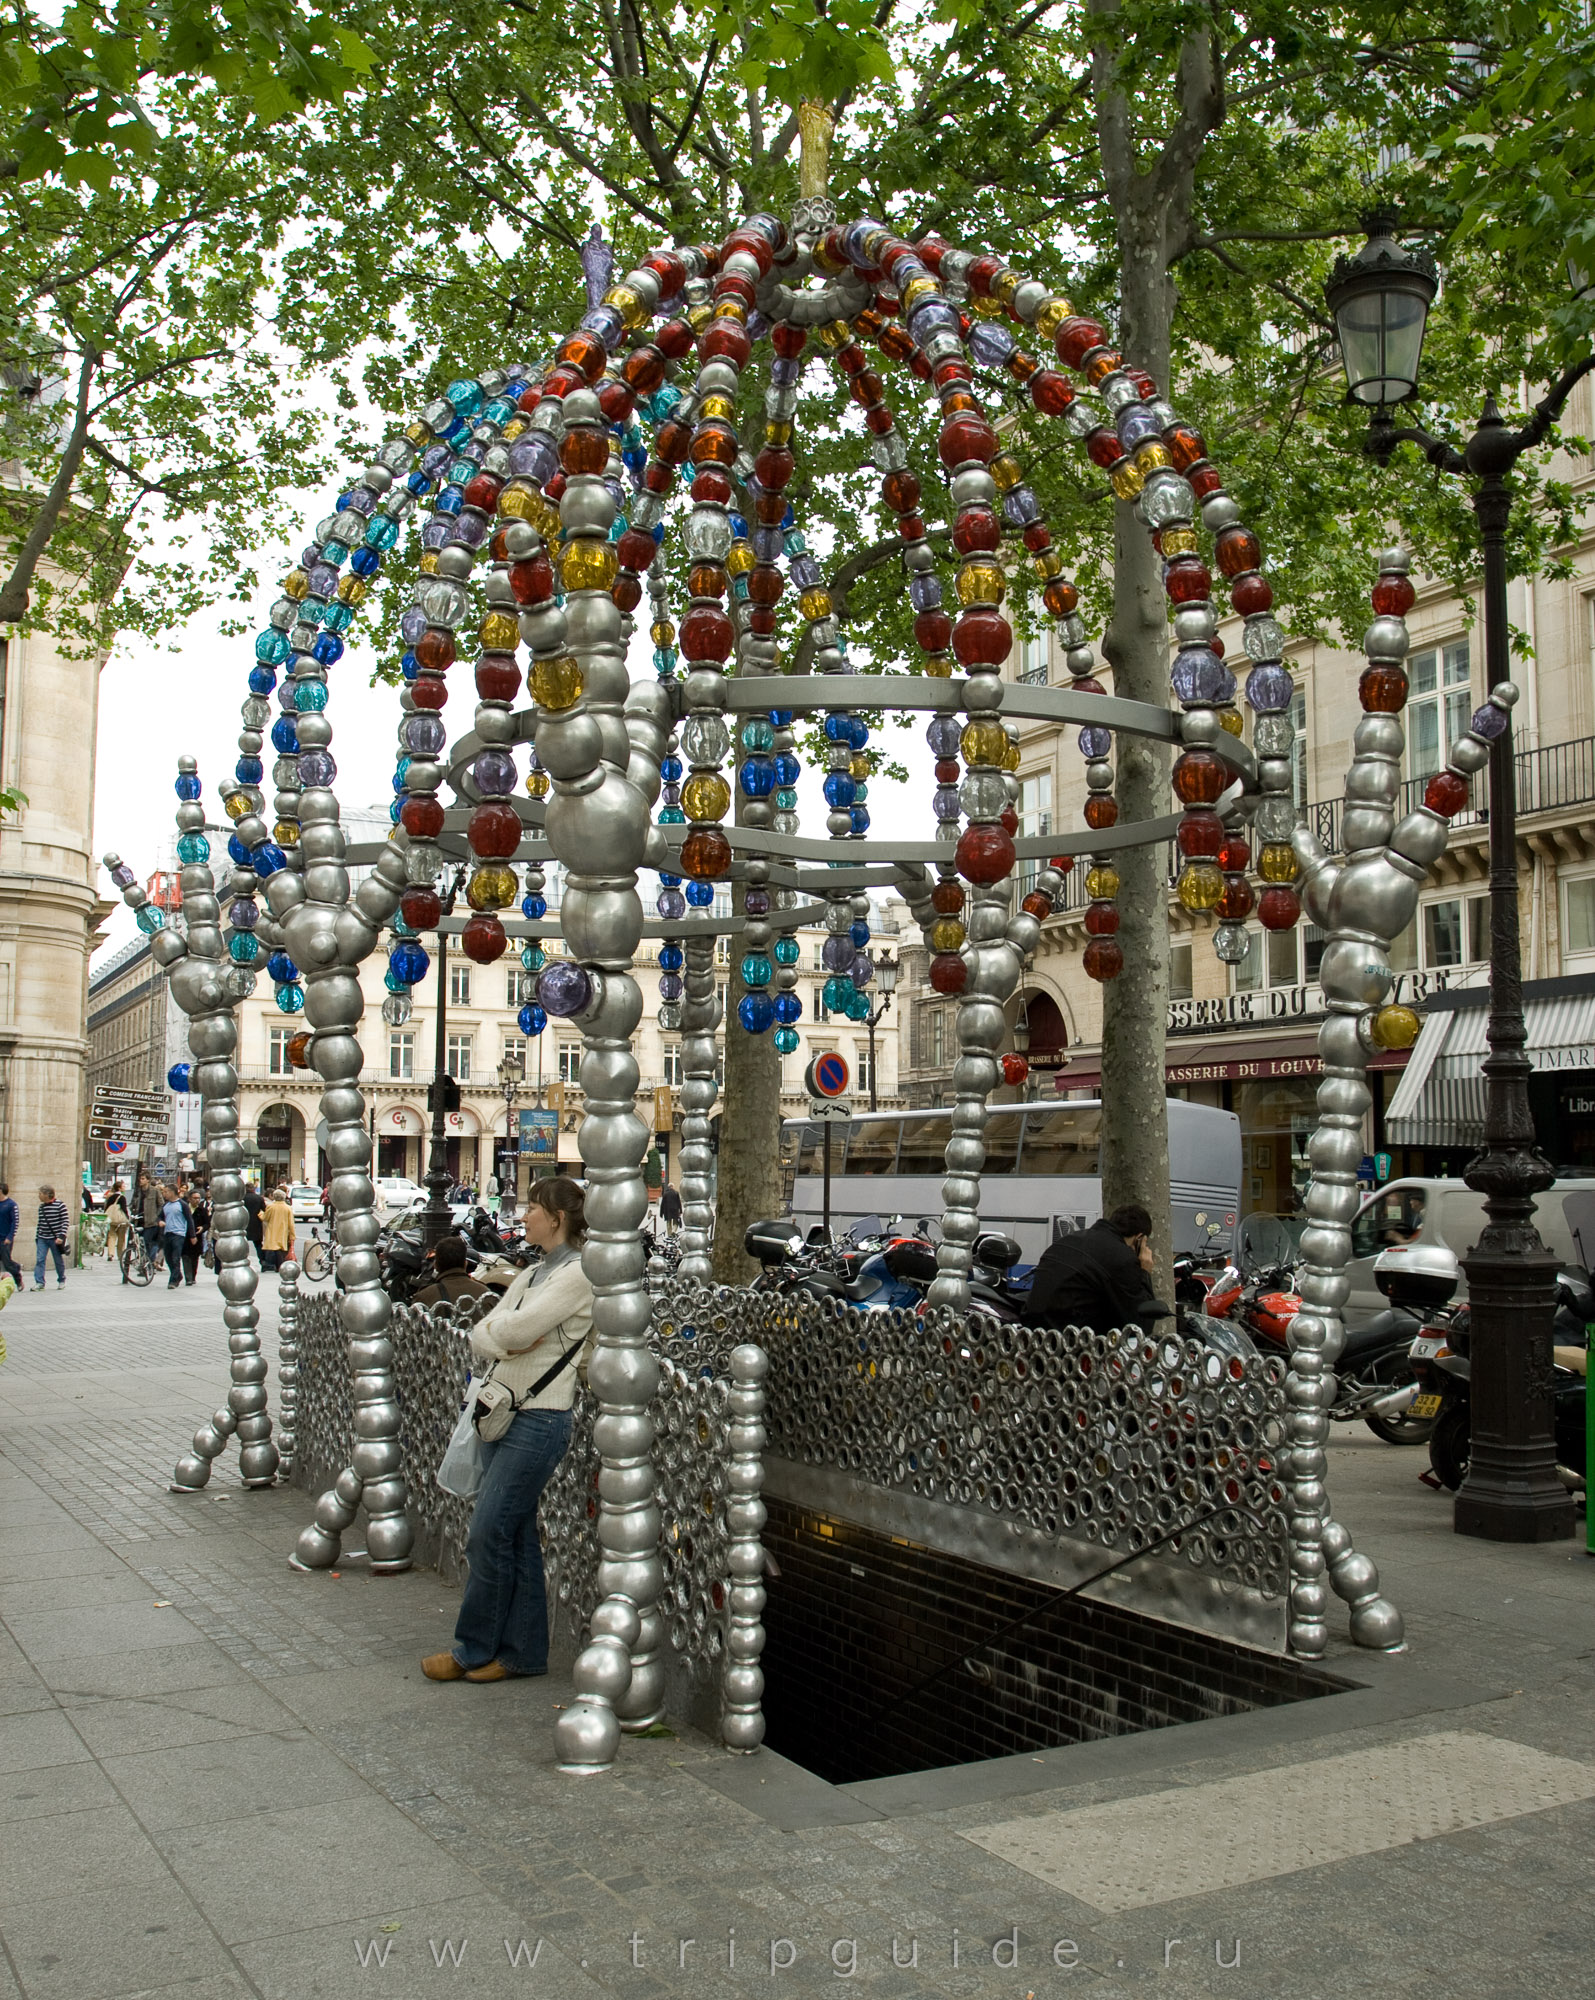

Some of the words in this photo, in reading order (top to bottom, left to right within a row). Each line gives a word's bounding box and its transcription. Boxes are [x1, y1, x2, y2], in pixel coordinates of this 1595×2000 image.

[1267, 987, 1306, 1018] DU
[1167, 1065, 1228, 1081] ASSERIE
[1239, 1063, 1260, 1076] DU
